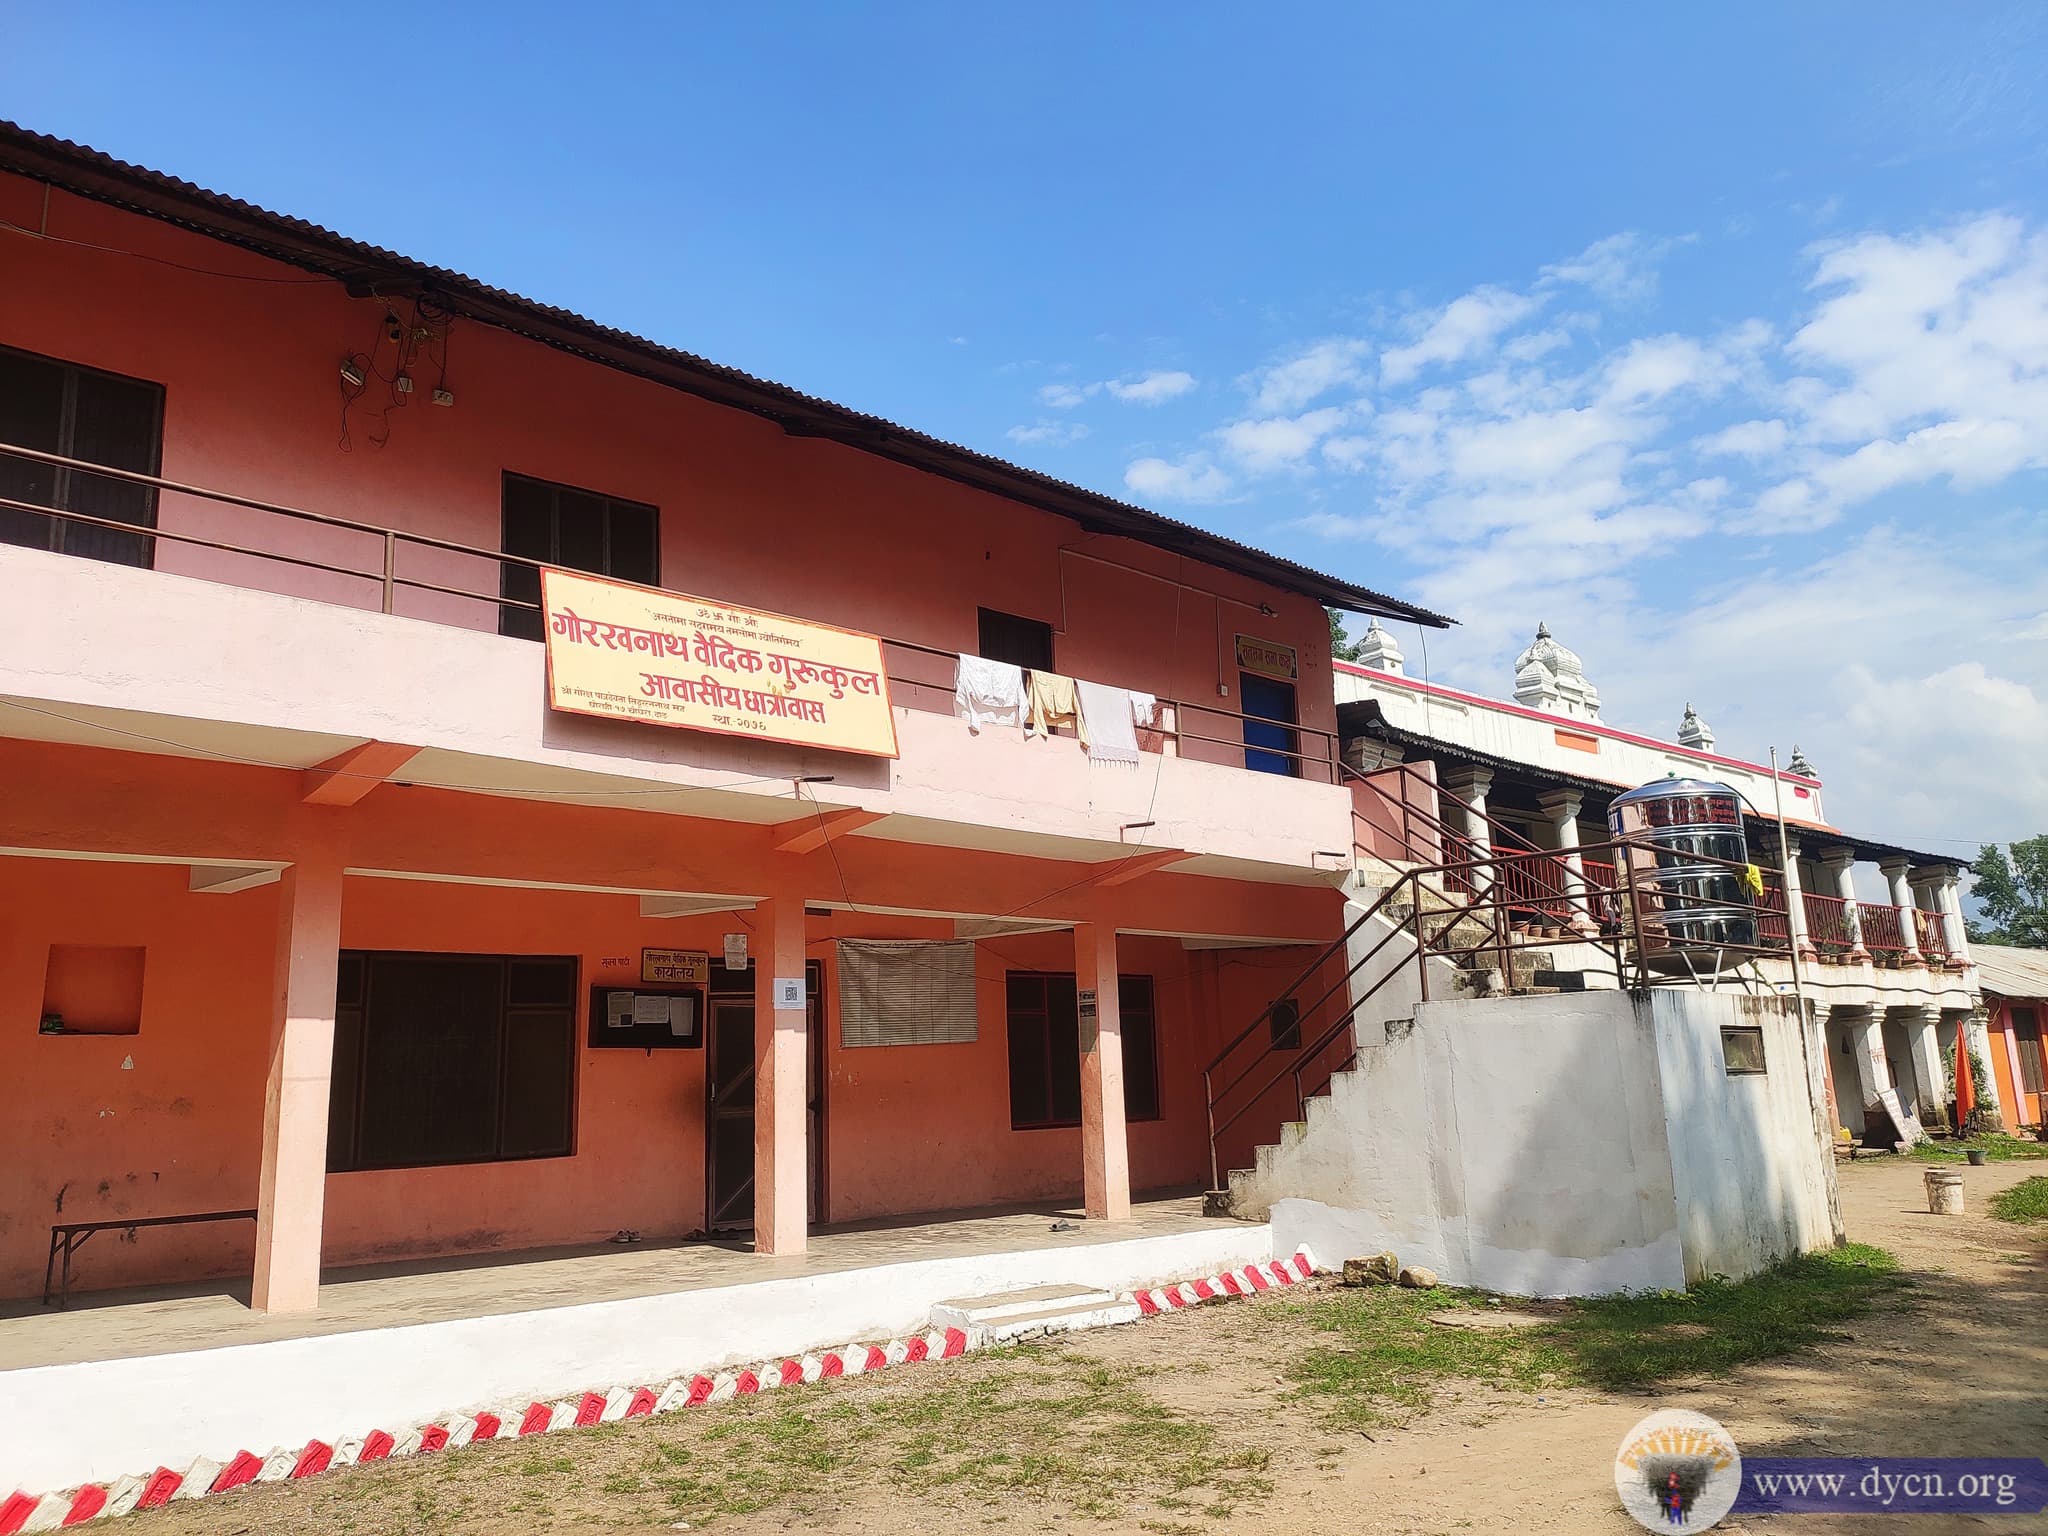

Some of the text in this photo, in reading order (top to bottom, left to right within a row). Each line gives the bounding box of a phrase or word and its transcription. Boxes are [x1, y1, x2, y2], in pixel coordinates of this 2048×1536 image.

[693, 630, 763, 673] वैदिक
[639, 672, 742, 710] आवासीय
[654, 964, 695, 979] कार्यालय
